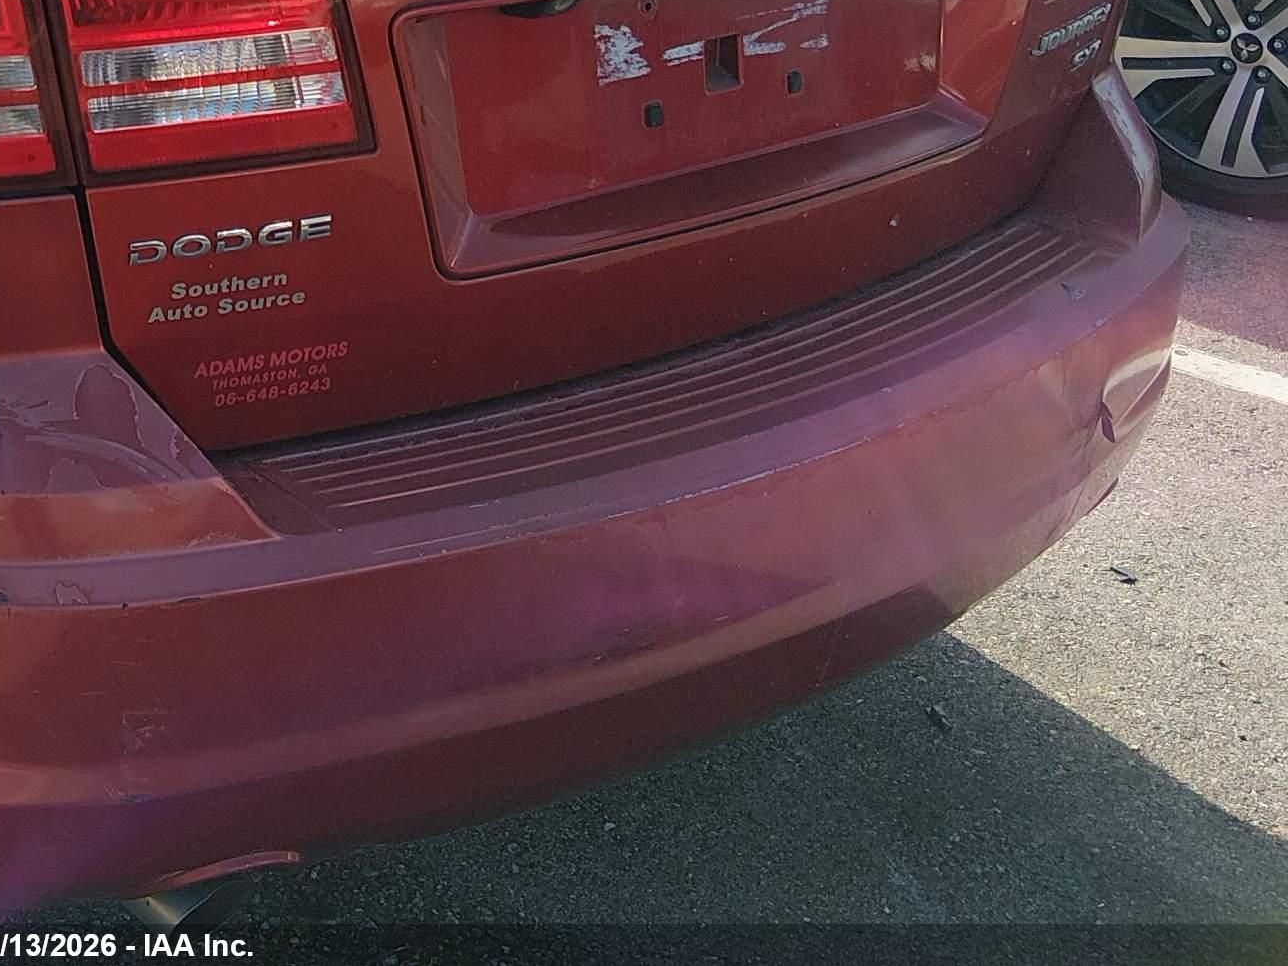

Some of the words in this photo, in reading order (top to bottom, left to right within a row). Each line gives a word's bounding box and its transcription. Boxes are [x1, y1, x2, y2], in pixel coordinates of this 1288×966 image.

[129, 214, 333, 266] DODGE
[171, 272, 288, 299] Southern
[147, 306, 209, 324] Auto
[217, 290, 306, 315] Source
[194, 354, 264, 378] ADAMS
[269, 341, 349, 367] MOTORS
[308, 364, 328, 375] GA
